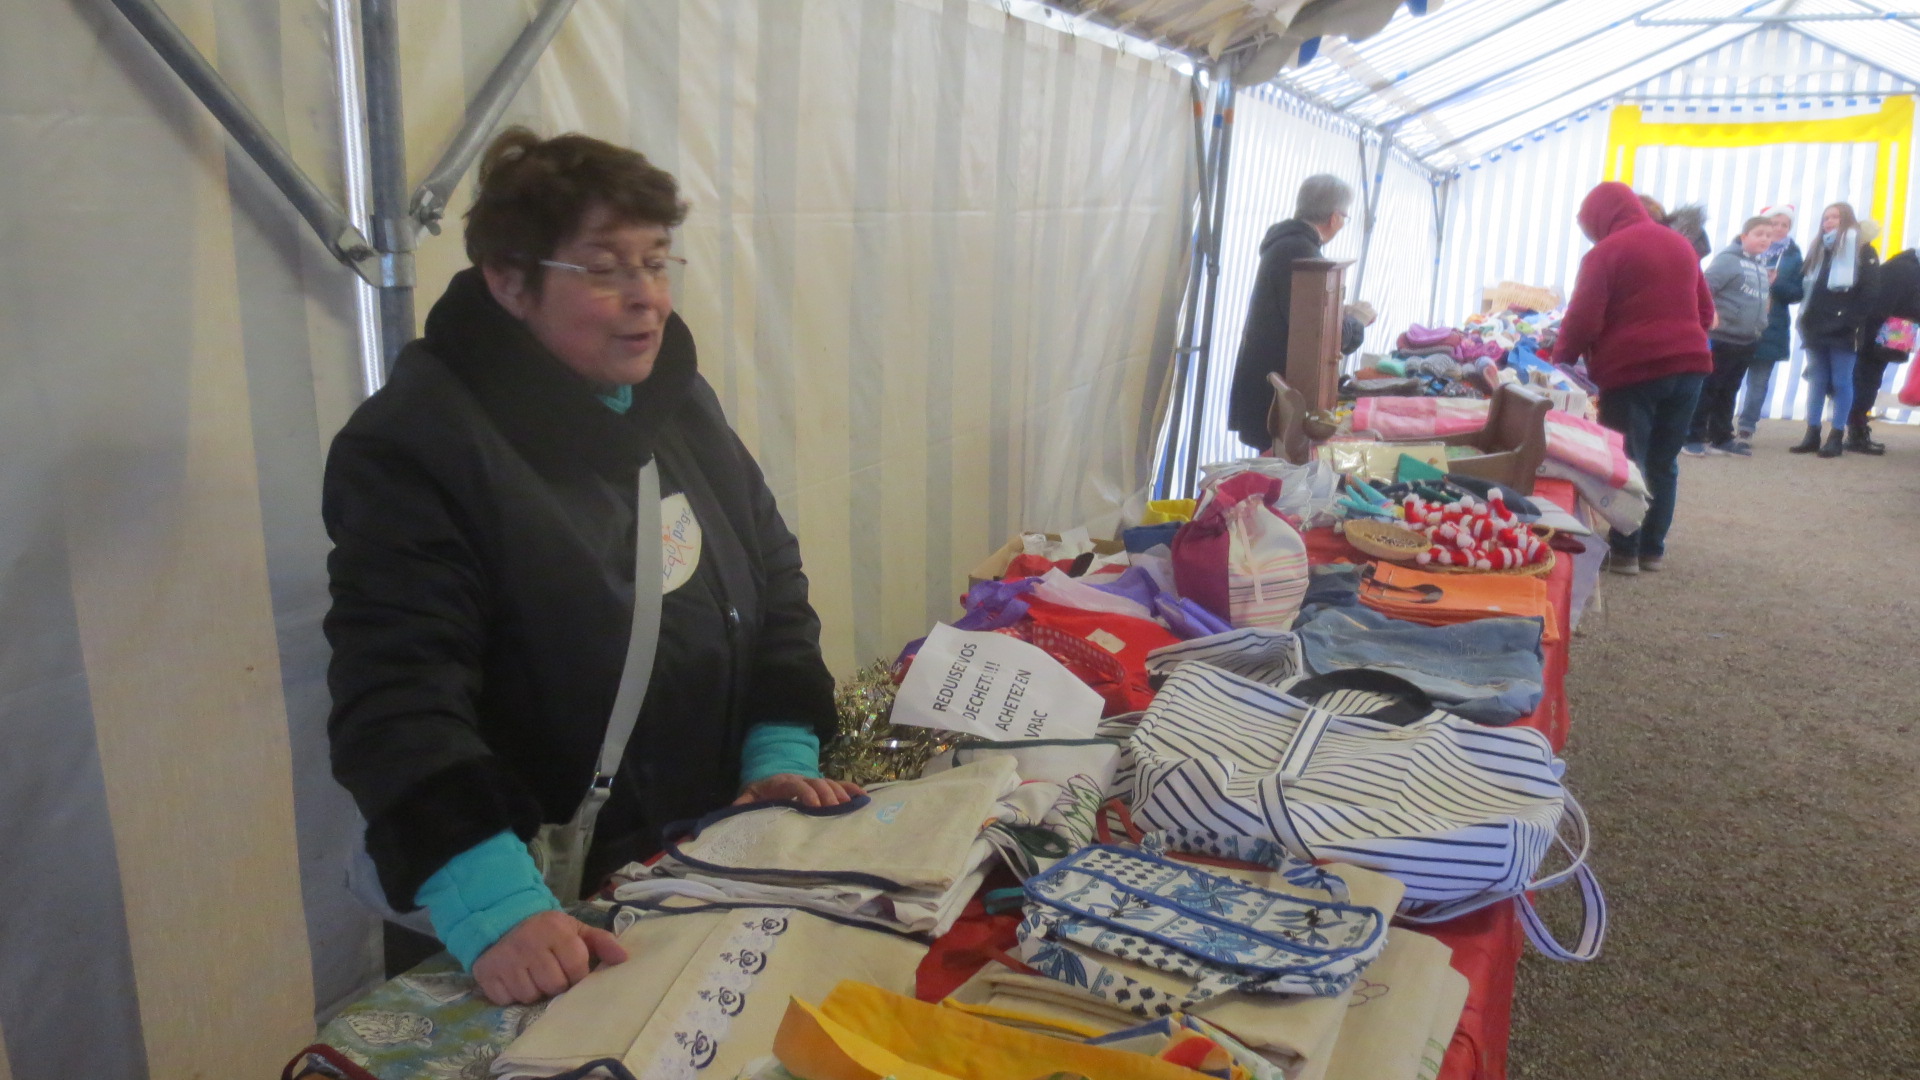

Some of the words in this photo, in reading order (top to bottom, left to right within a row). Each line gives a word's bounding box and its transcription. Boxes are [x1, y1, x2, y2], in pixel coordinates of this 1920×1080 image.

[933, 659, 967, 712] REDUISEZ
[958, 643, 978, 664] VOS
[995, 682, 1026, 732] ACHETEZ
[1015, 669, 1032, 685] EN
[1024, 709, 1049, 738] VRAC
